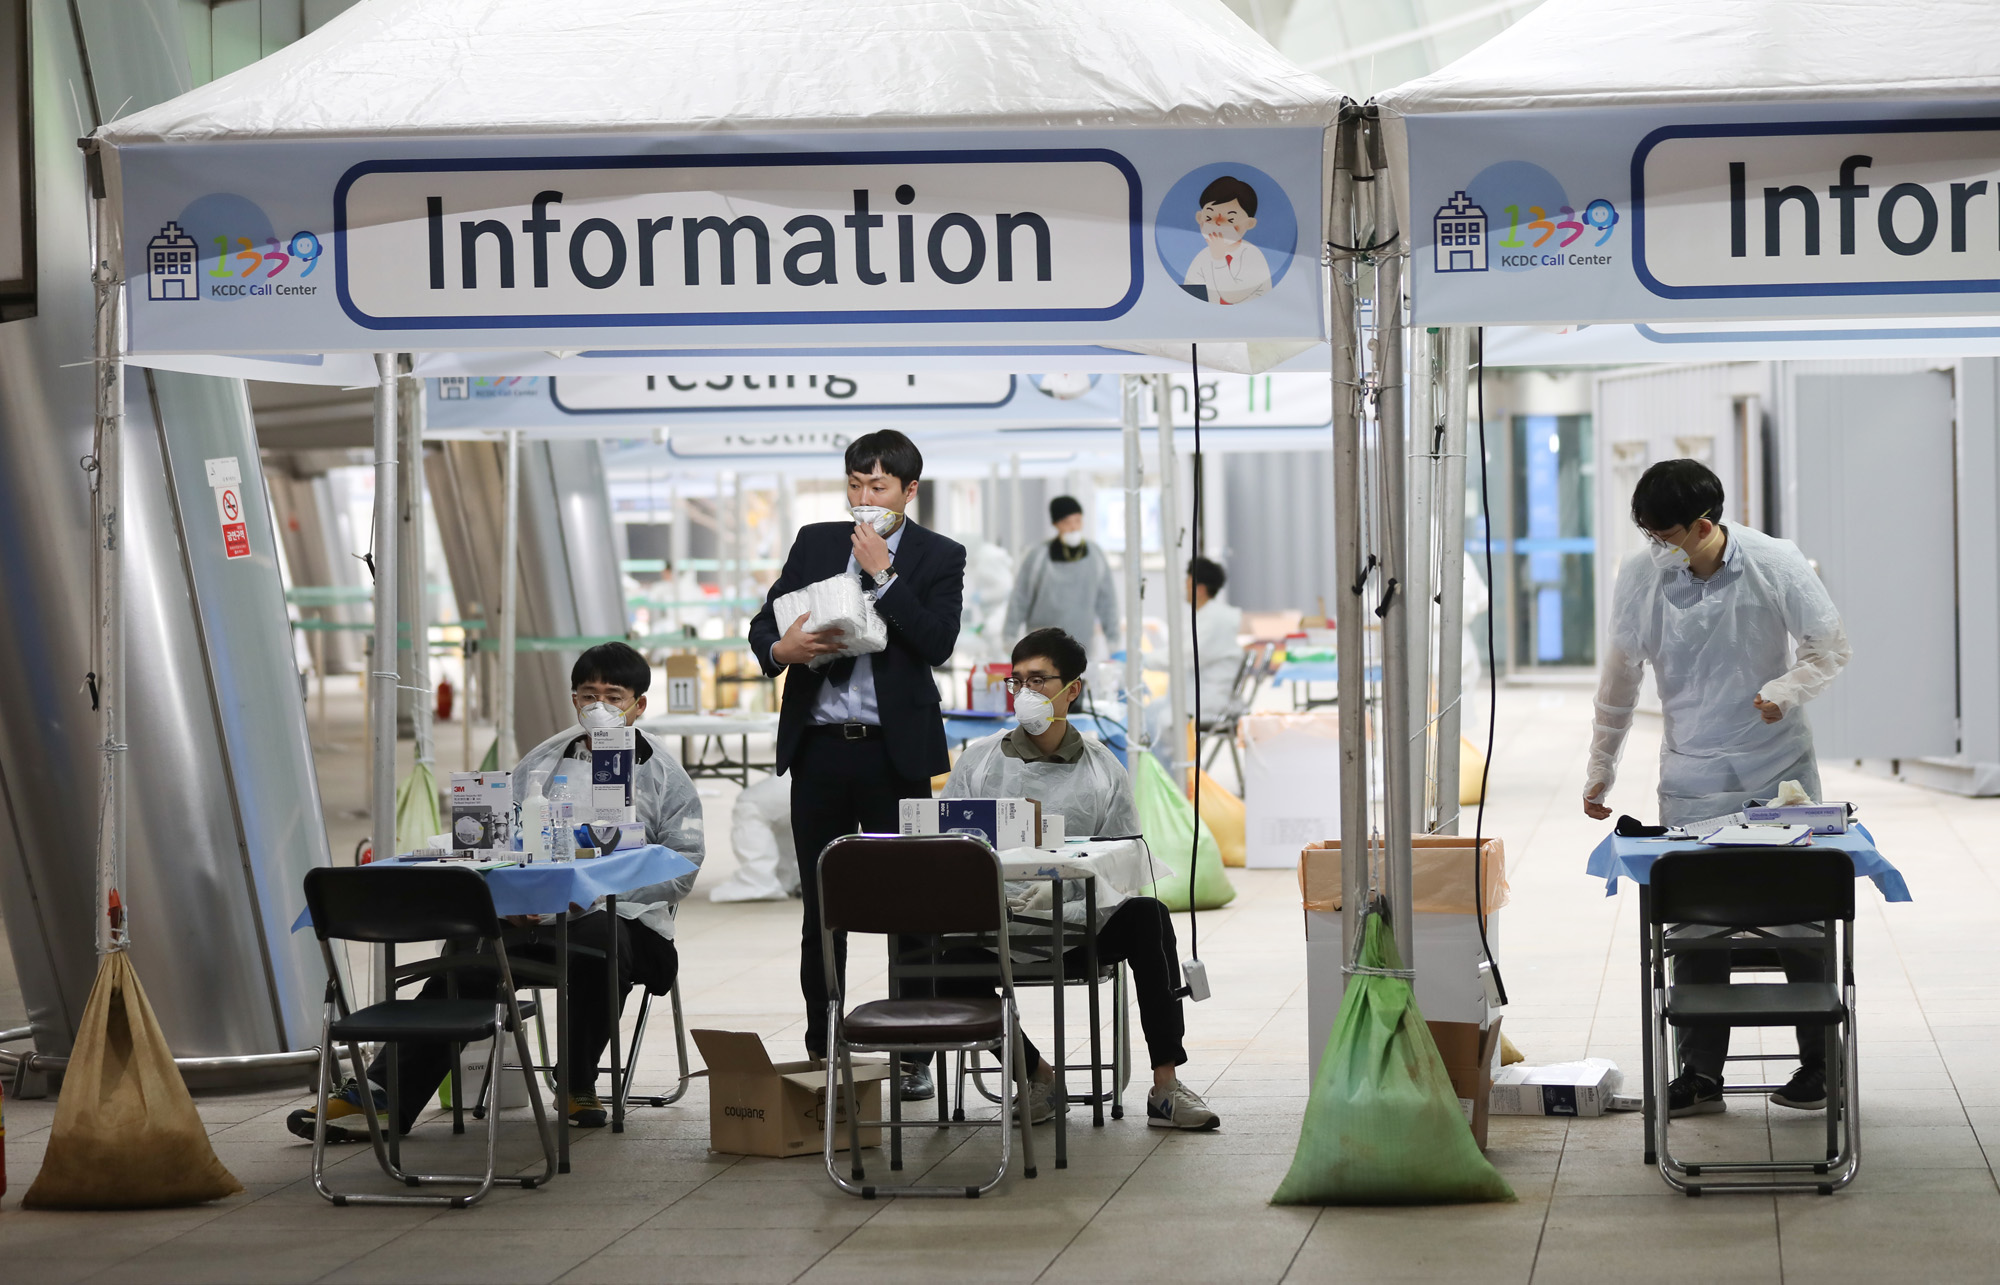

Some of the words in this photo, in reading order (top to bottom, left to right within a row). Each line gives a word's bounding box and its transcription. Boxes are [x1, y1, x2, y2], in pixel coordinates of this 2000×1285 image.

[1729, 155, 2000, 258] Infor
[427, 184, 1052, 289] Information
[1499, 199, 1619, 248] 1339
[209, 231, 322, 278] 1339
[1501, 255, 1538, 267] KCDC
[1541, 254, 1565, 266] Call
[1568, 254, 1612, 265] Center
[211, 285, 246, 296] KCDC
[249, 284, 272, 295] Call
[275, 284, 317, 295] Center
[226, 529, 246, 542] 금연구역
[725, 1105, 765, 1122] coupang
